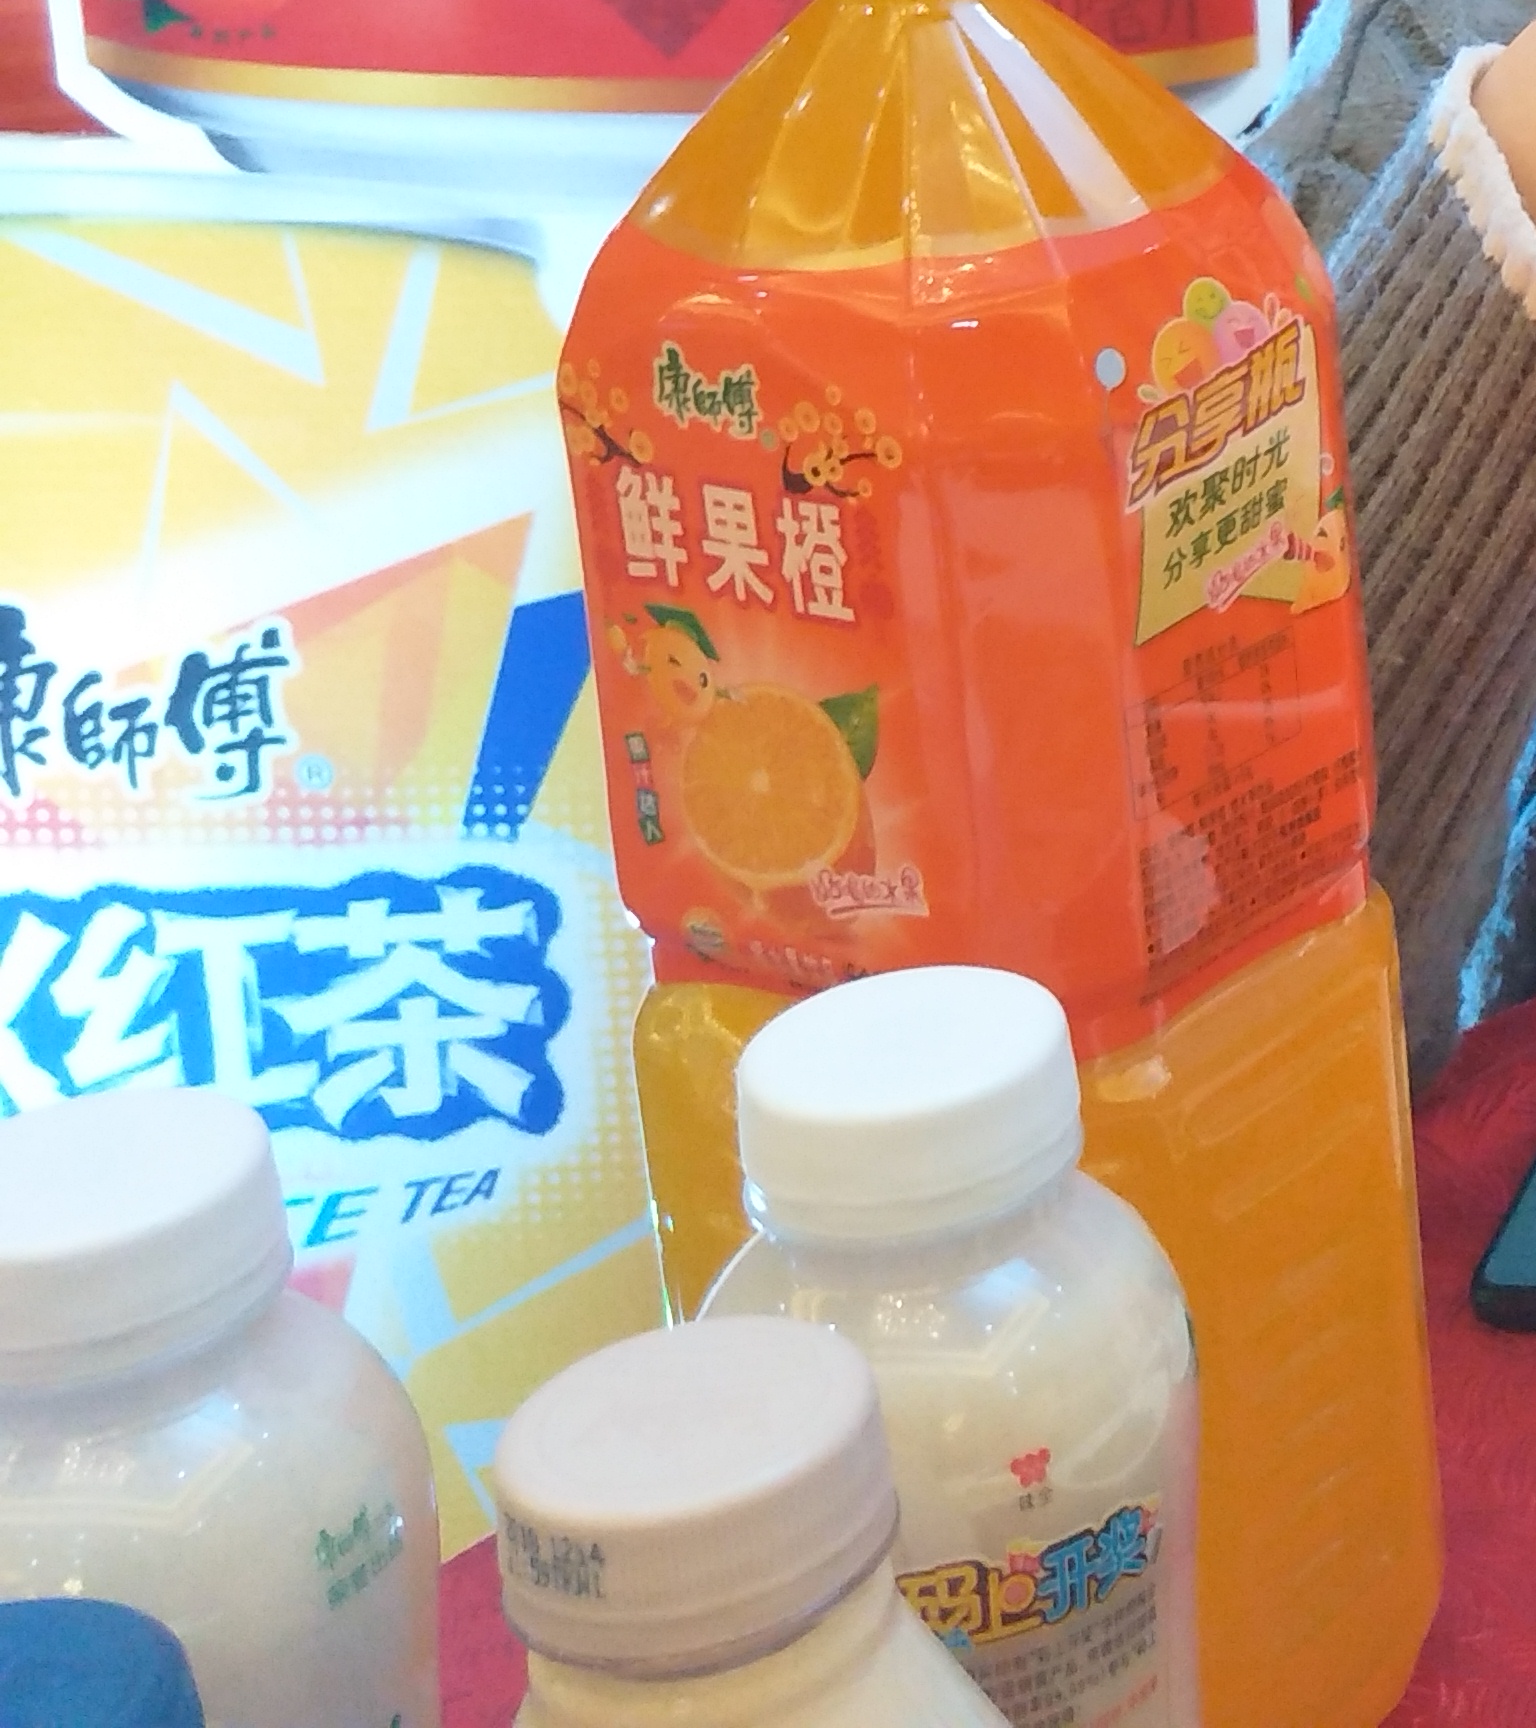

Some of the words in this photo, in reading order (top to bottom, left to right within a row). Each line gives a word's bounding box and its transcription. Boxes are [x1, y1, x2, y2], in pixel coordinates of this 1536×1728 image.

[1127, 320, 1306, 504] 分享瓶
[1163, 478, 1288, 589] 分享更甜蜜
[1165, 426, 1290, 538] 欢聚时光
[615, 467, 855, 623] 鲜果橙
[401, 1167, 501, 1225] TEA
